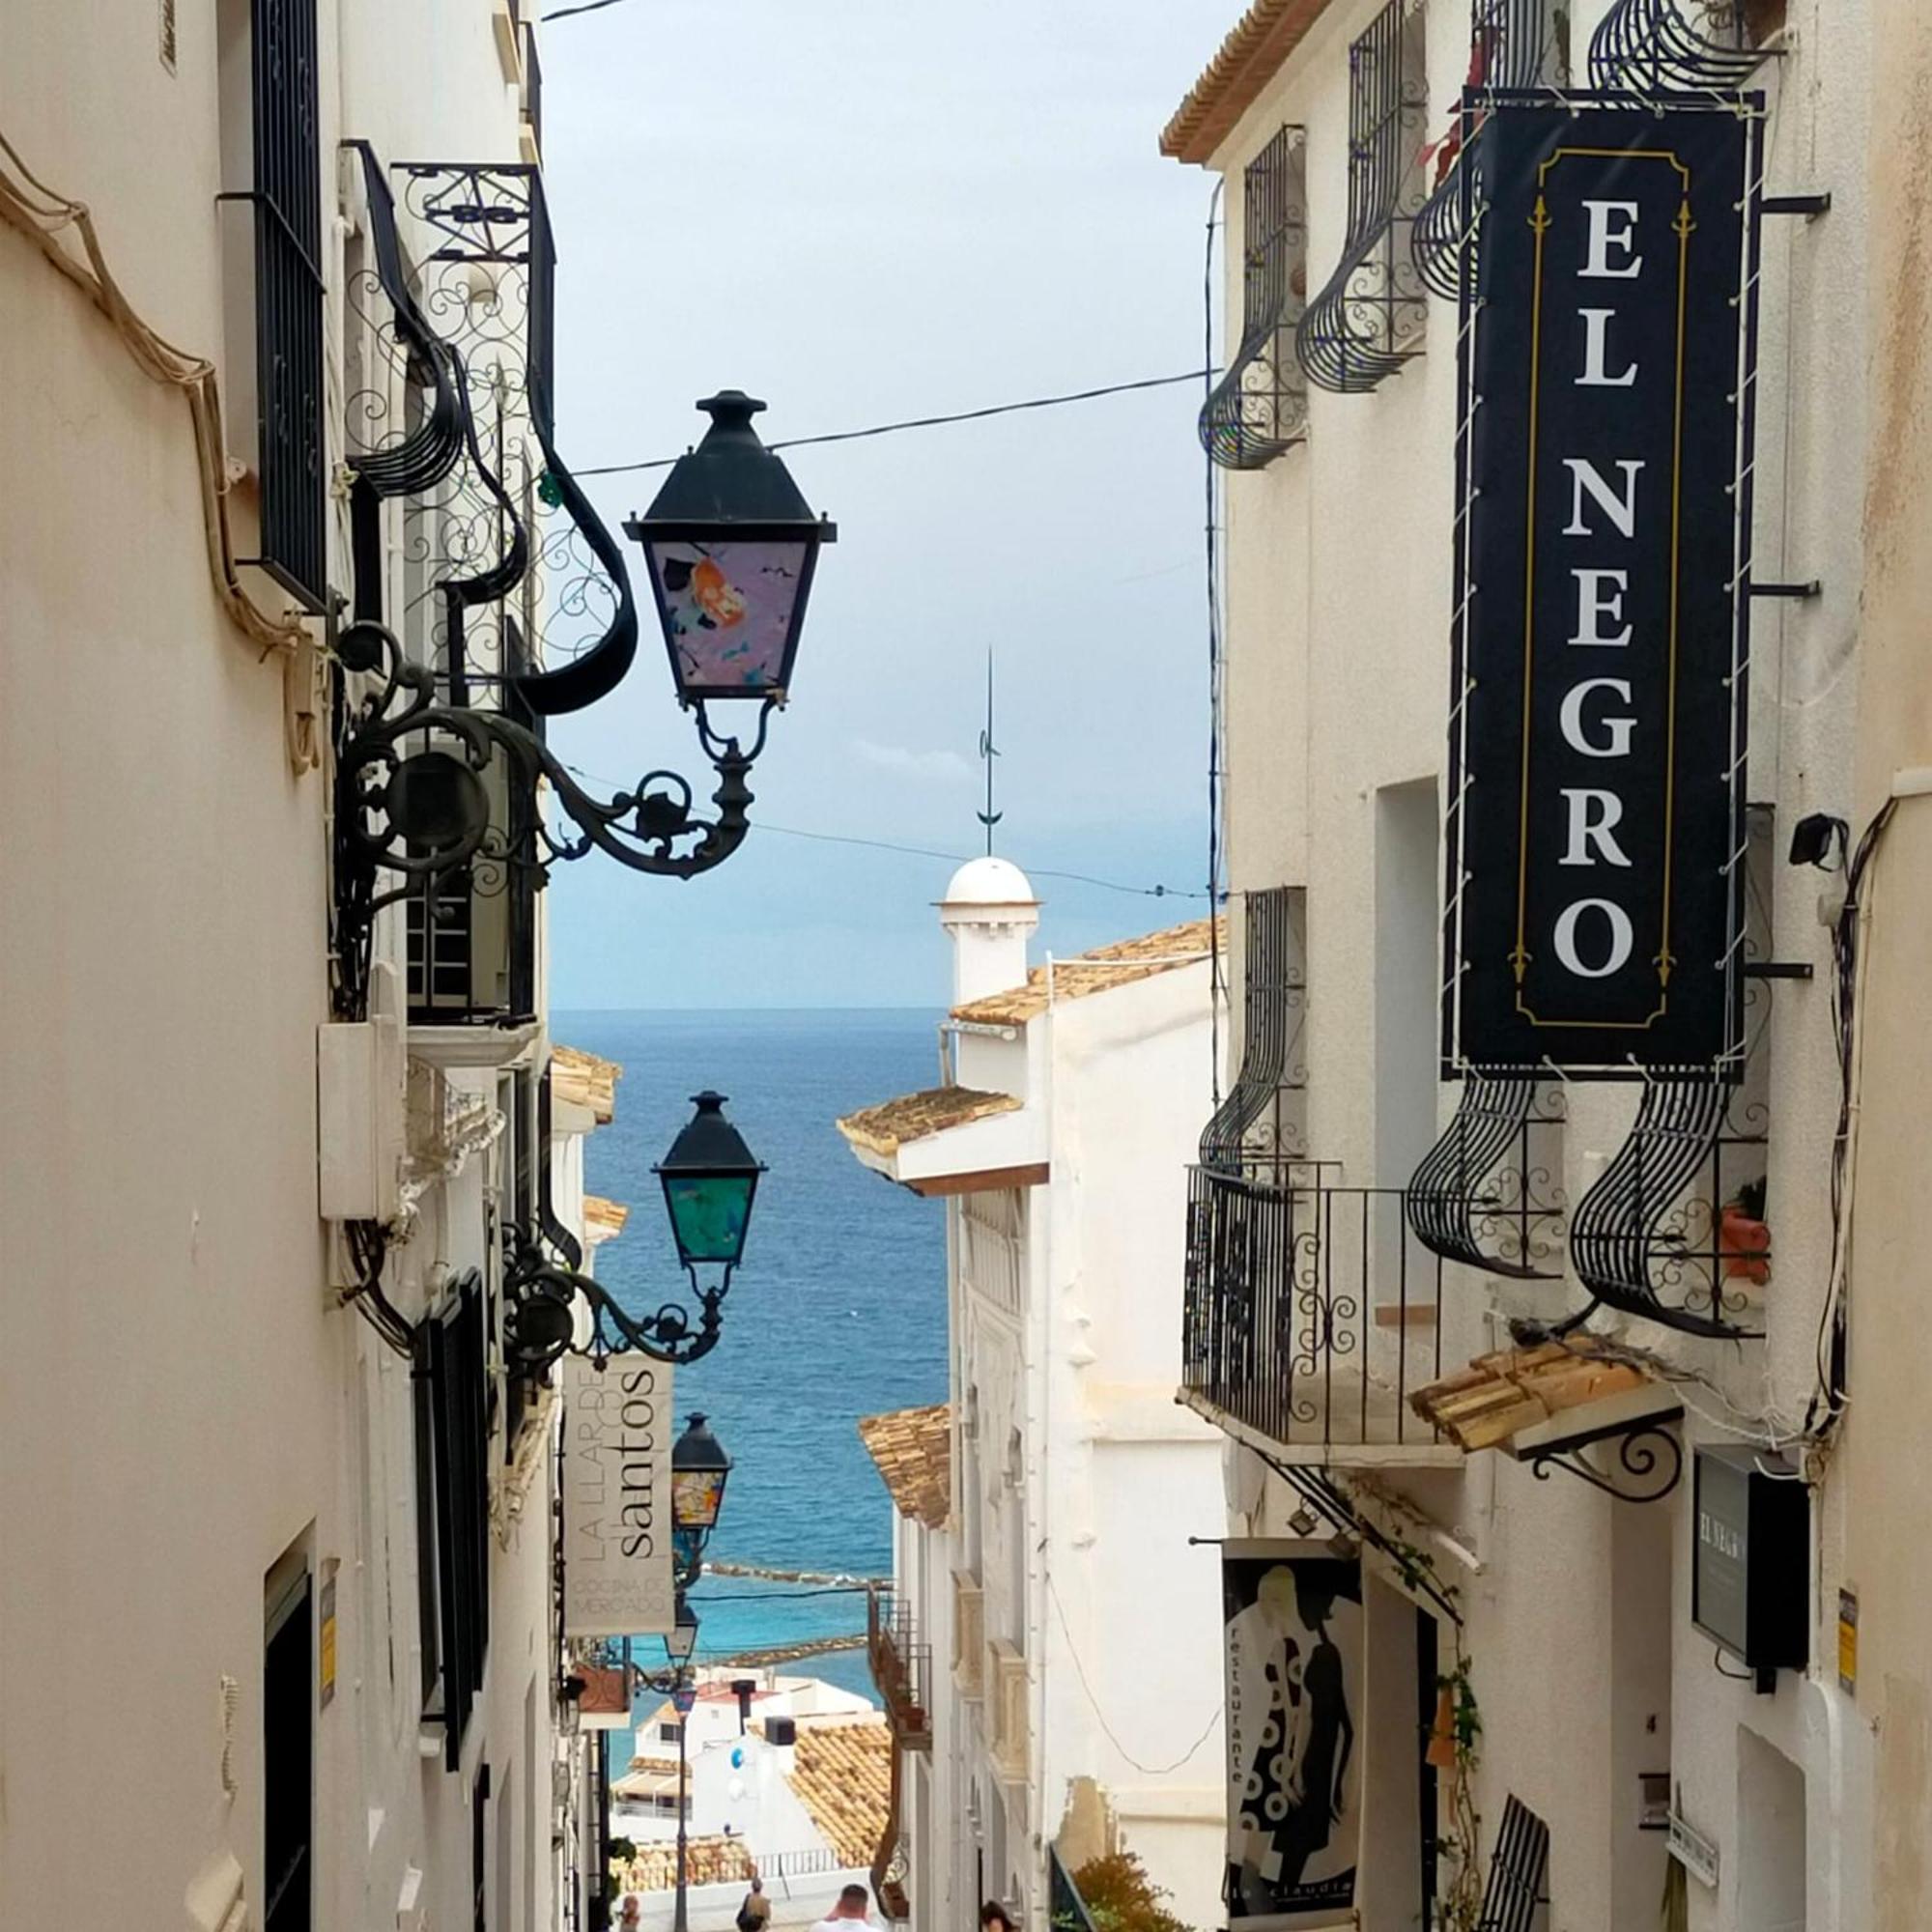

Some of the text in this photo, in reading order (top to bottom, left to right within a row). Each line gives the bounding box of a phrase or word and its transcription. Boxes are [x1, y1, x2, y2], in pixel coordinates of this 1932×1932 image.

[1552, 199, 1647, 979] EL NEGRO
[578, 1371, 606, 1562] LA LLAR DE
[603, 1369, 655, 1559] santos
[573, 1596, 666, 1614] MERCADO
[1231, 1627, 1243, 1784] restaurante
[1232, 1887, 1252, 1899] la
[1268, 1882, 1353, 1898] claudia
